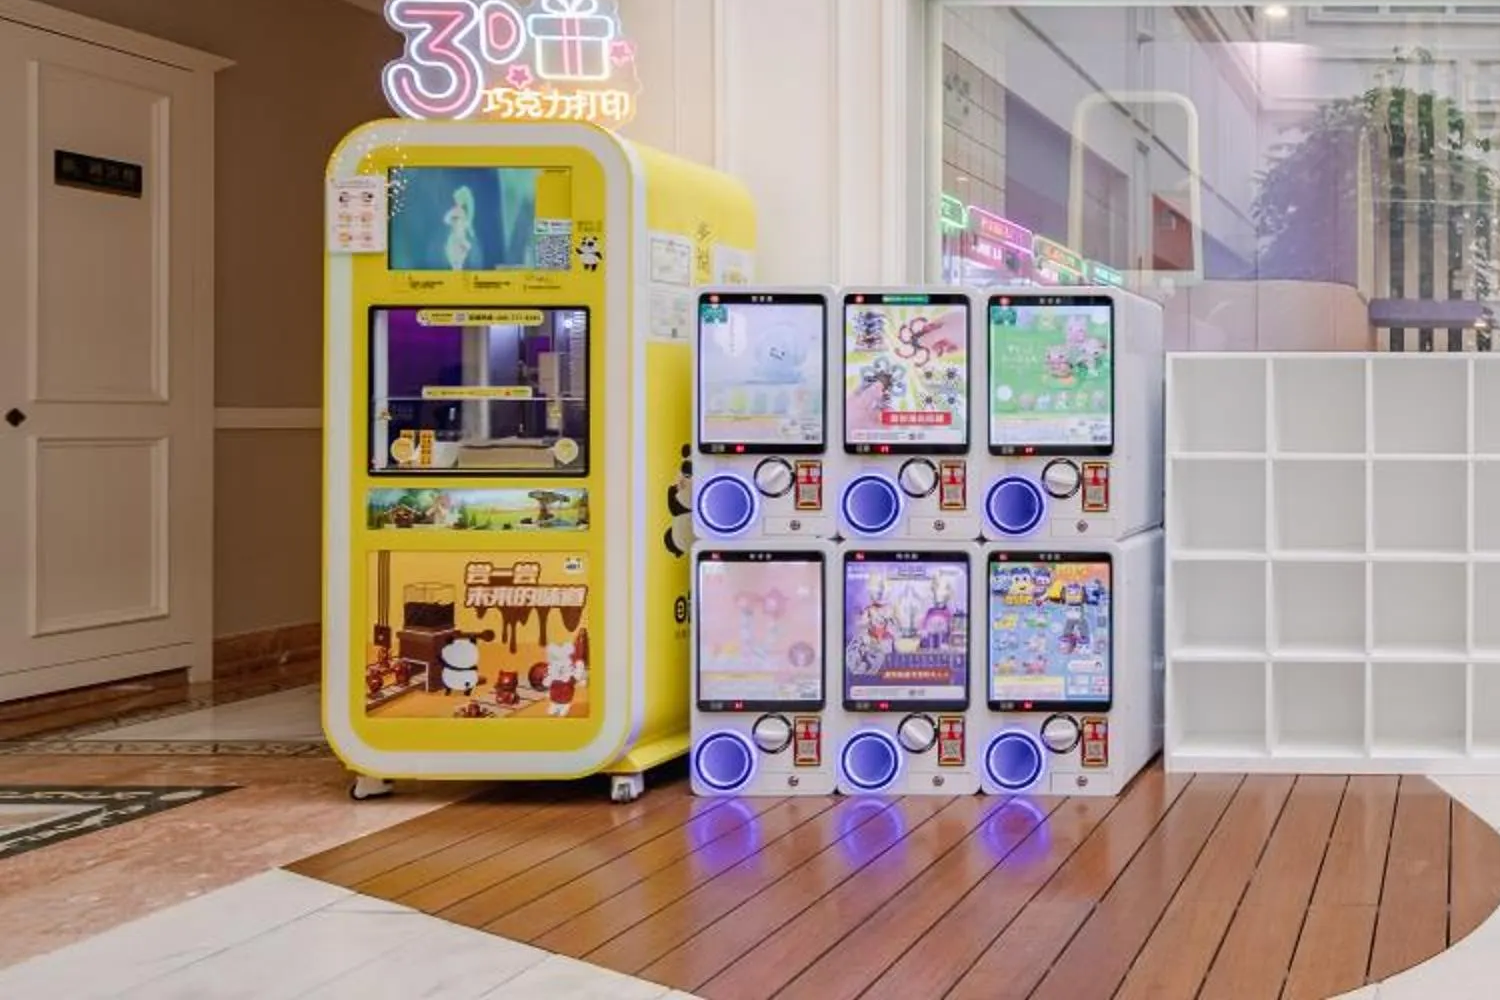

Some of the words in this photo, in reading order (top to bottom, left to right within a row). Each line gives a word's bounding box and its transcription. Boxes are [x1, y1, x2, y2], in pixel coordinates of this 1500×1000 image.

[479, 87, 631, 120] 巧克力打印
